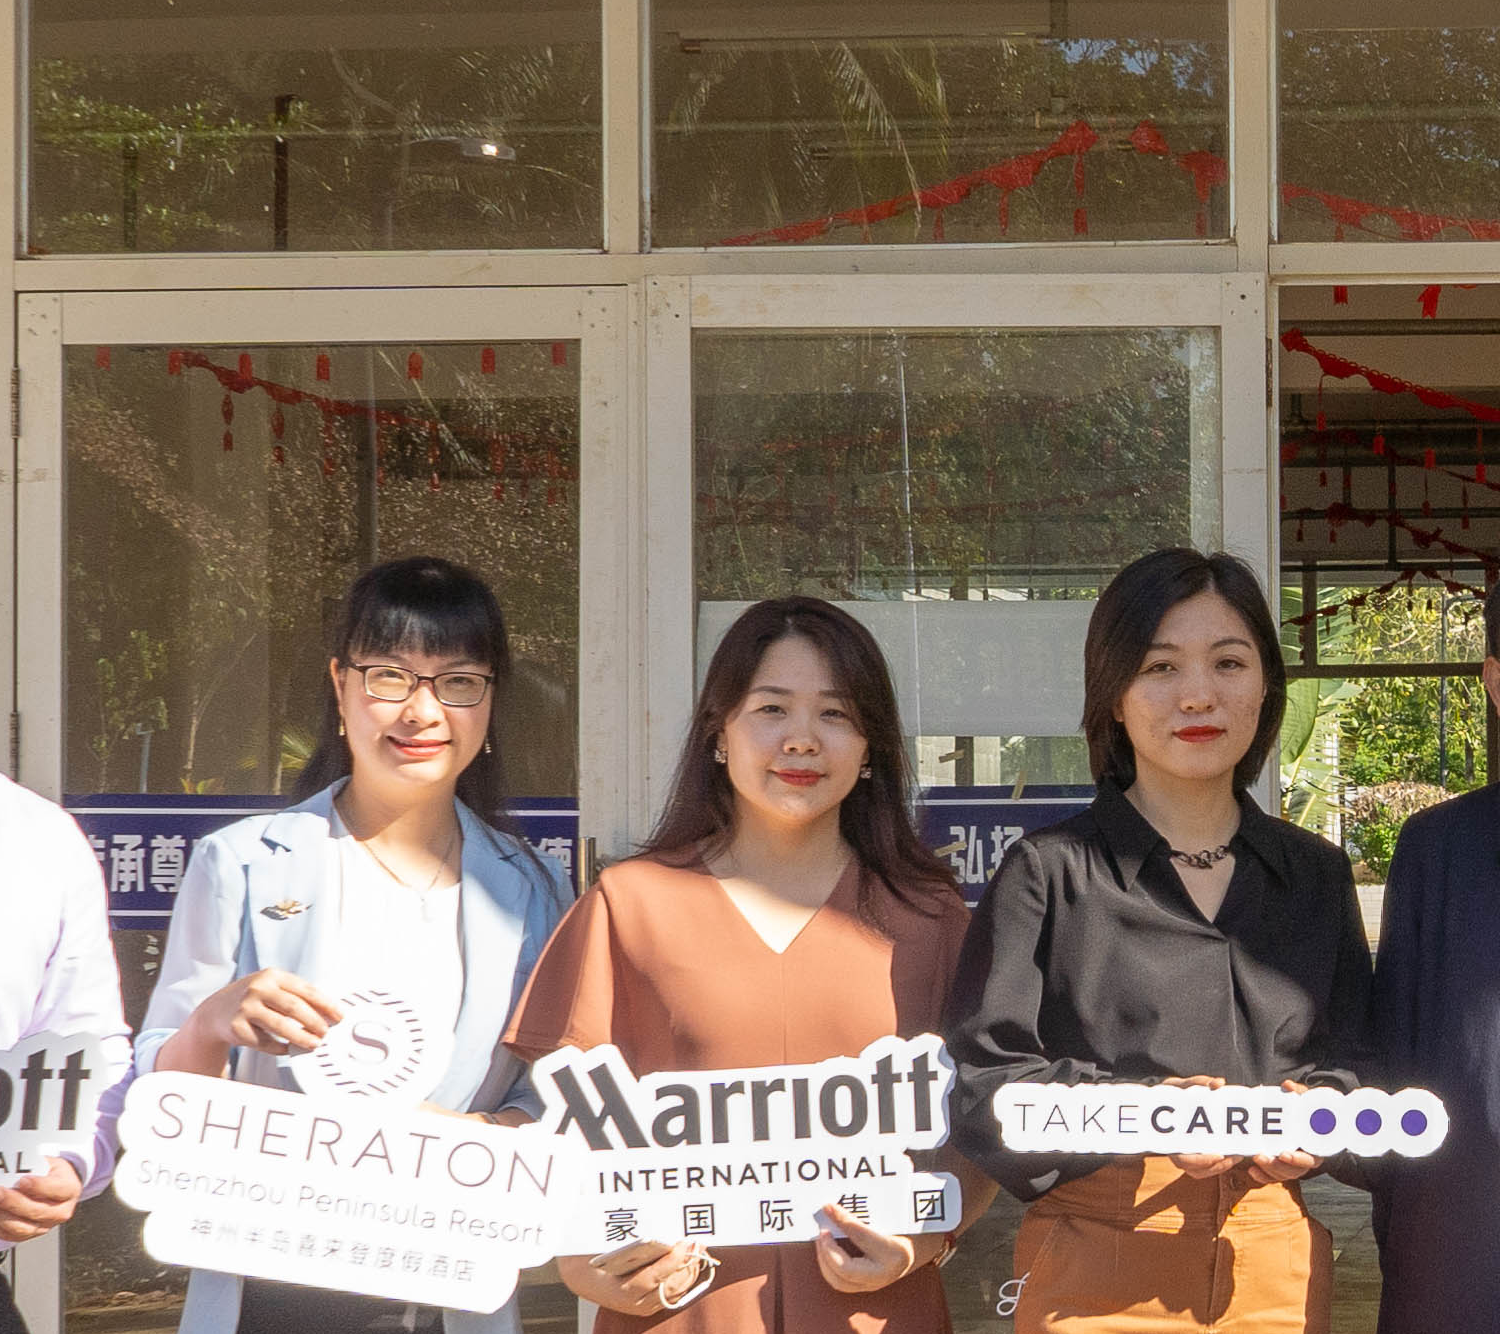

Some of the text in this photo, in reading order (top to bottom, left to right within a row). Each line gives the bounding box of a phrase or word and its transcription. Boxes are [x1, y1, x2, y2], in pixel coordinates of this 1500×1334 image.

[150, 1092, 555, 1197] SHERATON
[550, 1051, 939, 1151] Marriott
[137, 1158, 546, 1246] Shenzhou Peninsula Resort
[600, 1155, 897, 1194] INTERNATIONAL
